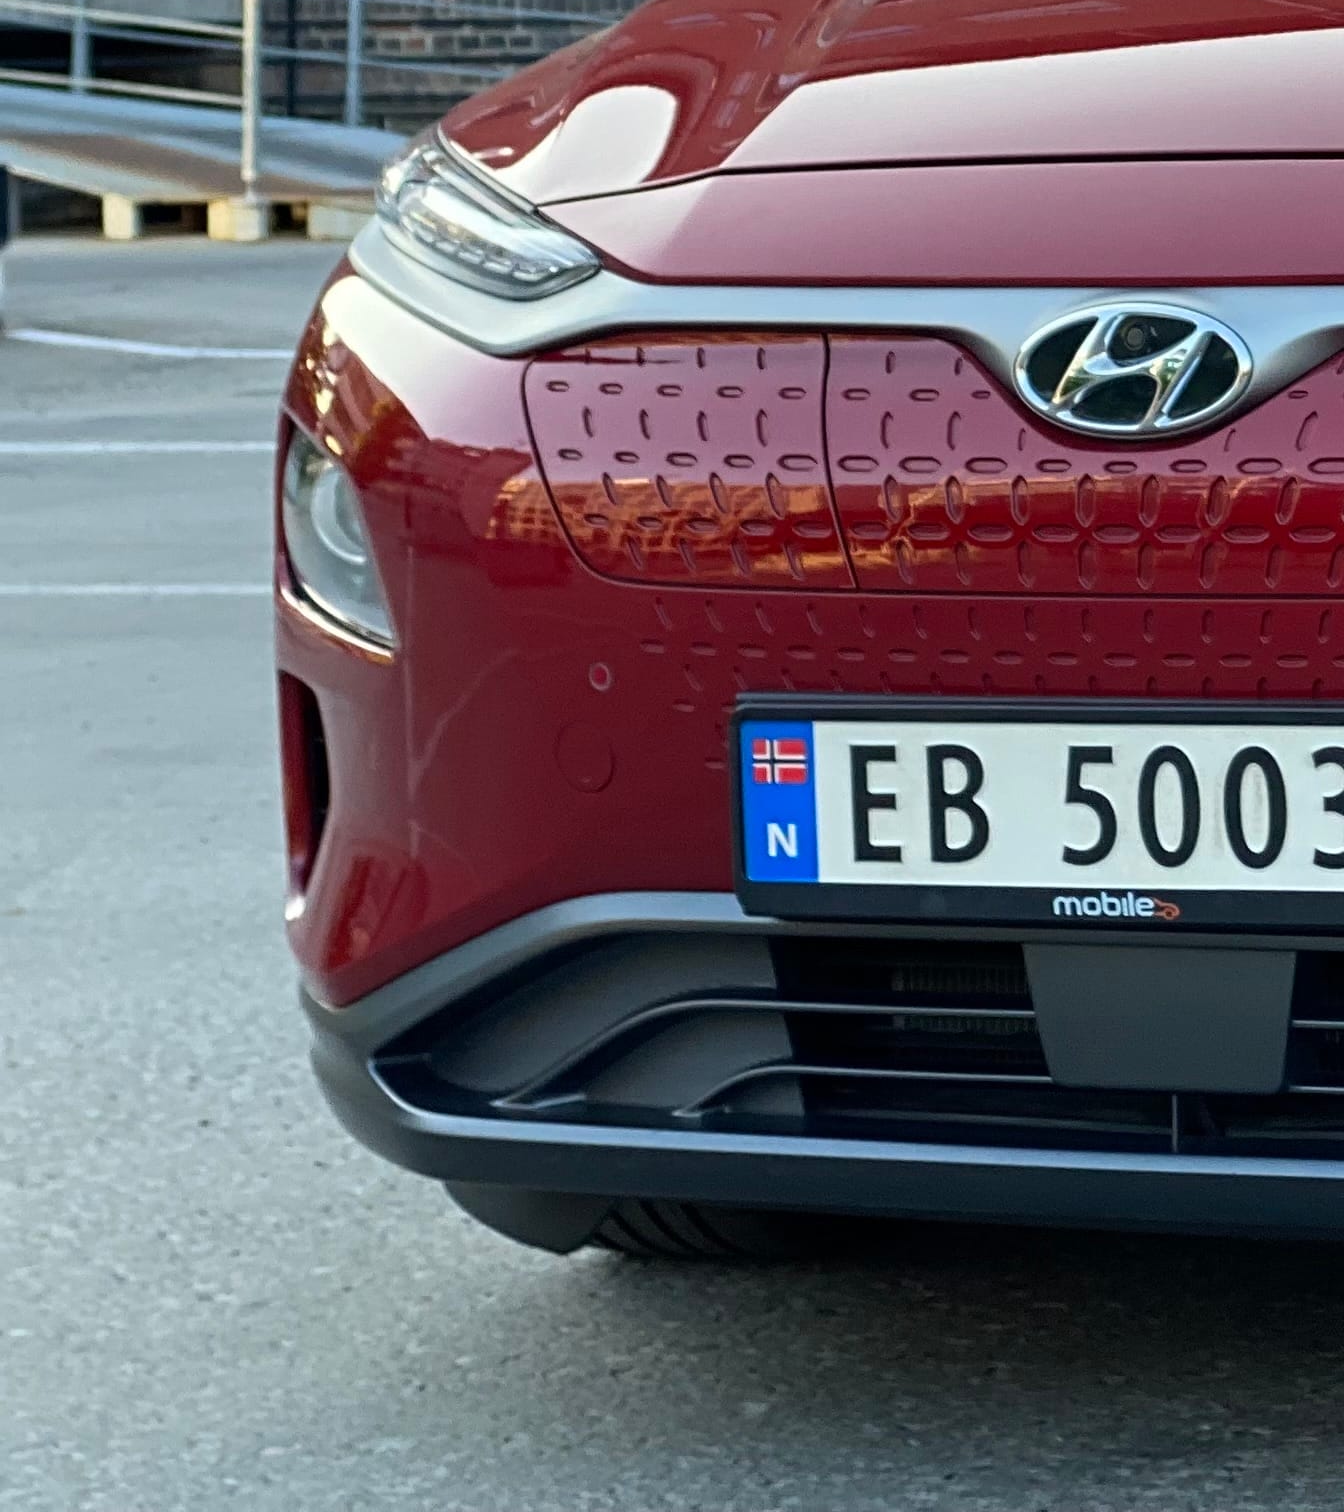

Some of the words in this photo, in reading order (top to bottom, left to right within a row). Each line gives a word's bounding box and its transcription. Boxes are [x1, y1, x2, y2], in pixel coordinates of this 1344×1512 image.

[849, 744, 990, 864] EB
[767, 823, 798, 858] N
[1053, 891, 1155, 917] mobile
